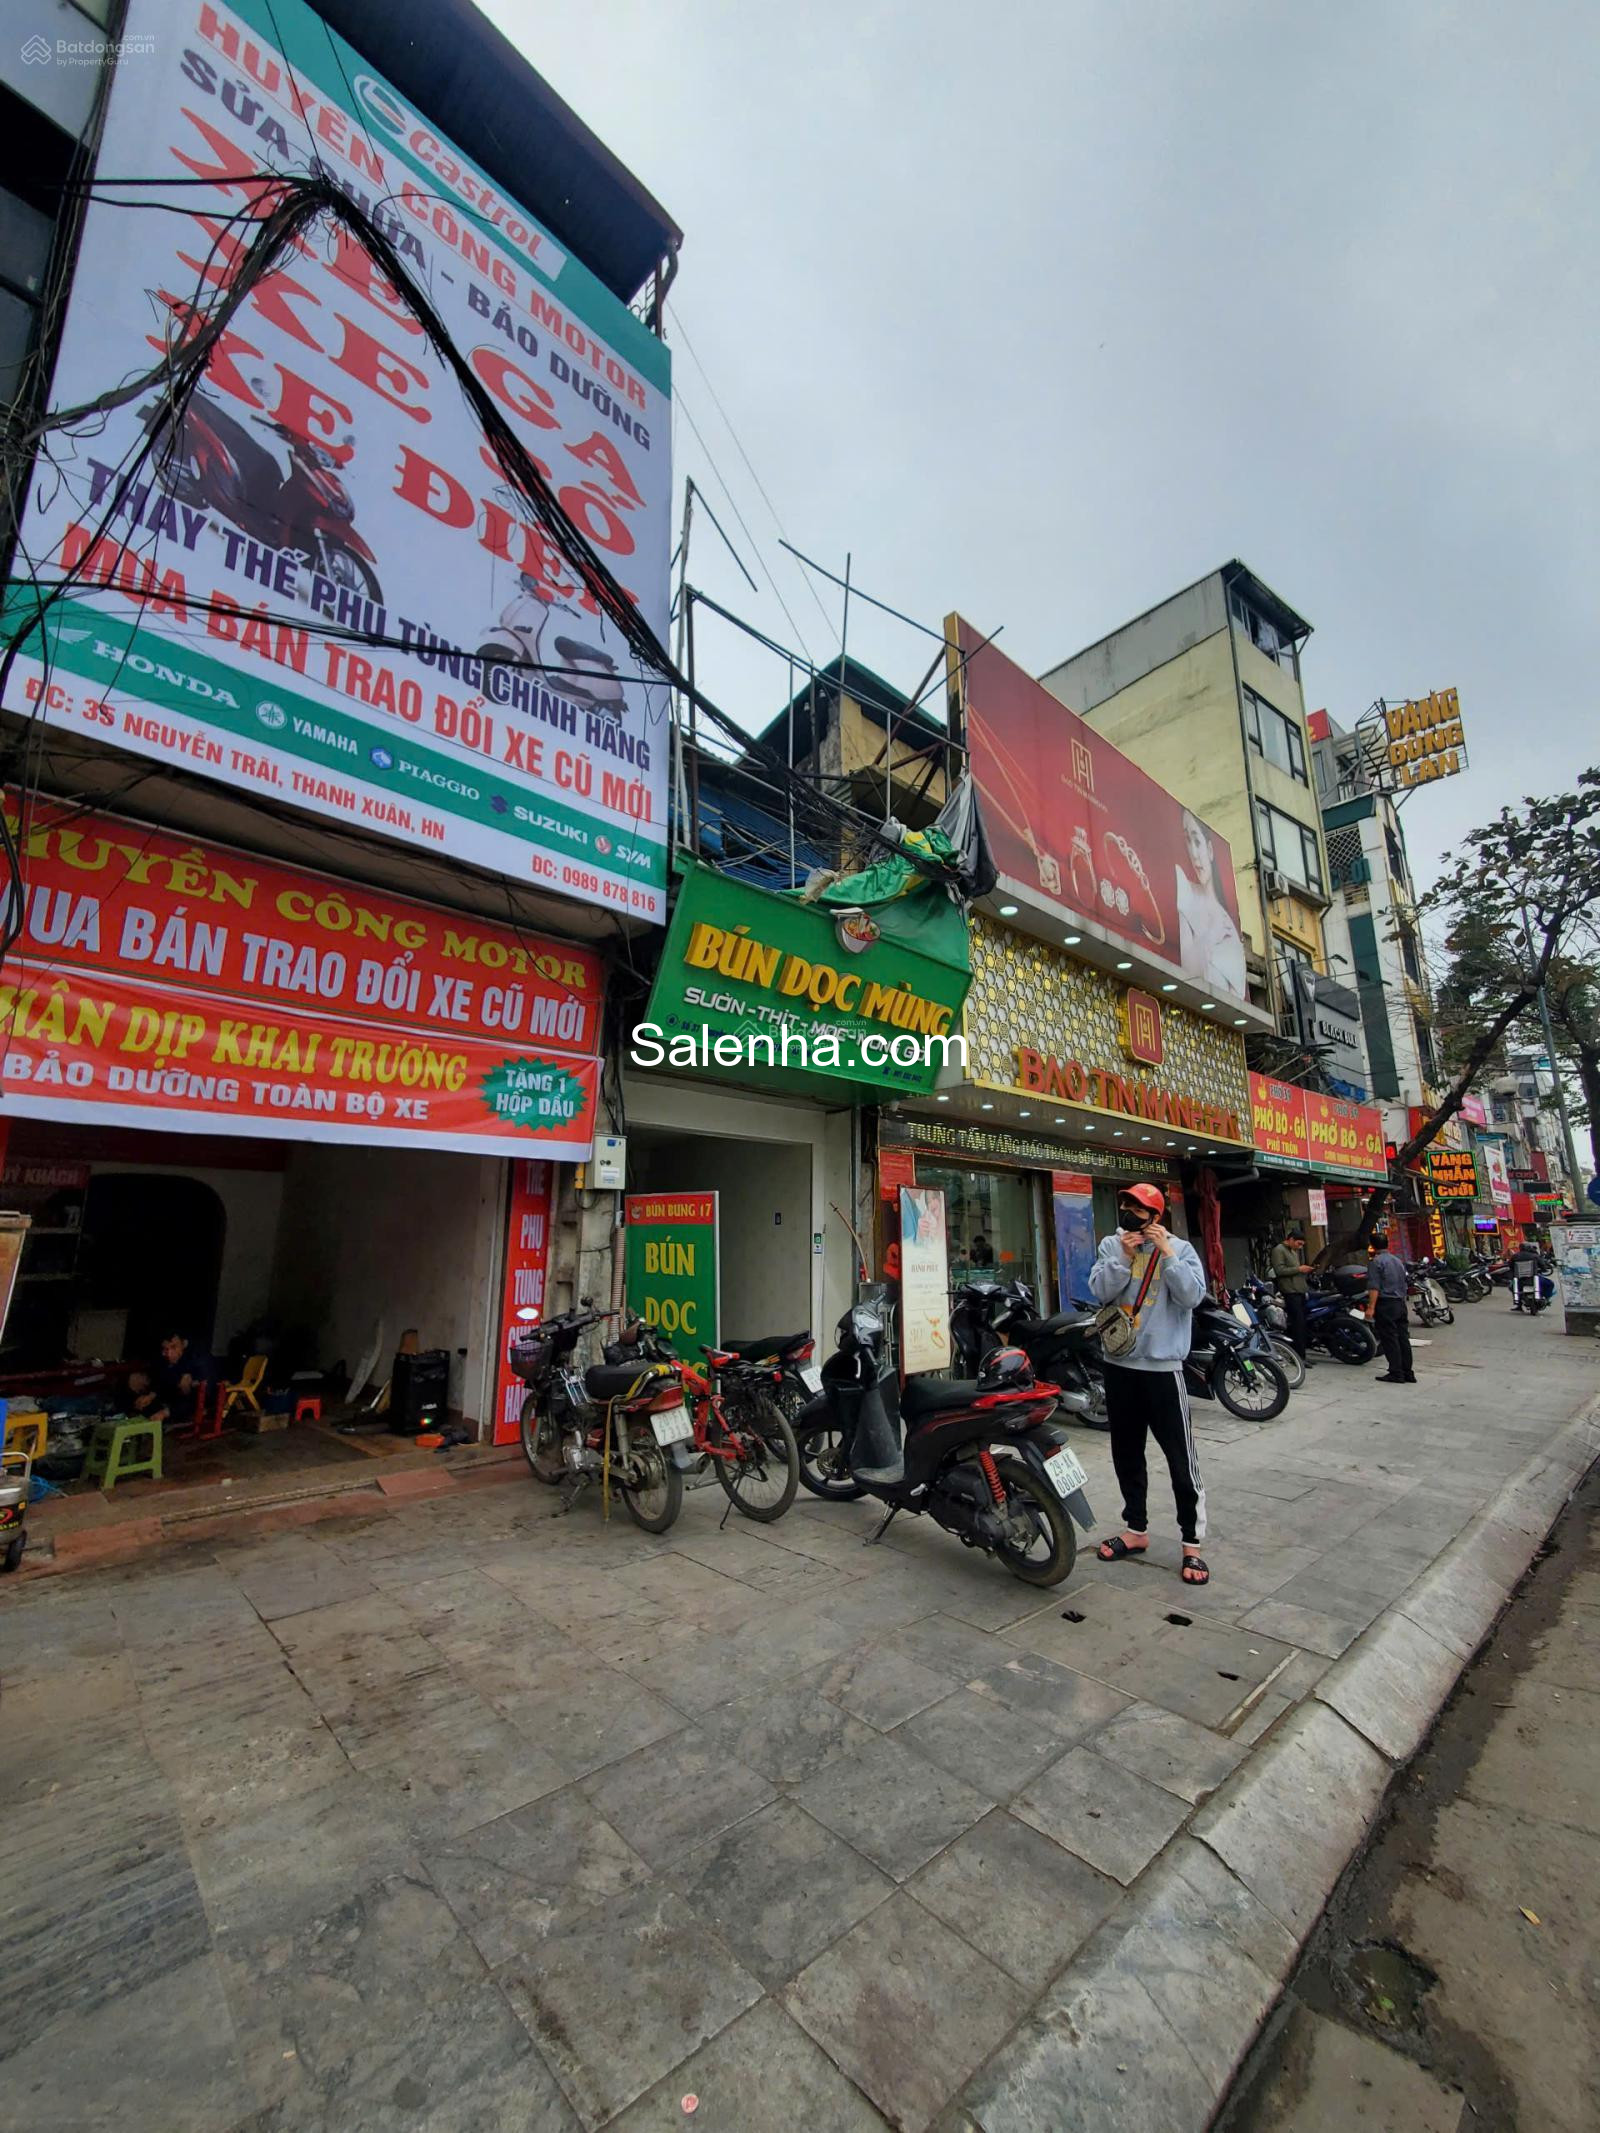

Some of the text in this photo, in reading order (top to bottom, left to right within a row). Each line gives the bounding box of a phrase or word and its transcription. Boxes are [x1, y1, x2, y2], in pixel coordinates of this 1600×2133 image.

[408, 129, 540, 261] Castrol
[180, 49, 289, 160] SỬA
[468, 282, 538, 357] BẢO
[550, 349, 650, 451] DƯỠNG
[402, 181, 517, 298] CÔNG
[530, 289, 647, 411] MOTOR
[472, 348, 647, 508] GA
[87, 457, 210, 551] THAY
[398, 615, 483, 694] TÙNG
[491, 664, 577, 736] CHÍNH
[586, 713, 650, 771] HÃNG
[60, 522, 652, 824] MUA BÁN TRAO ĐỔI XE CŨ MỚI
[25, 677, 445, 841] ĐC: 35 NGUYỄN TRÃI, THANH XUÂN, HN
[92, 639, 651, 869] HONDA YAMAHA PIAGGIO SUZUKI SYM
[531, 854, 655, 912] ĐC: 0989 878 816
[119, 905, 227, 977] BÁN
[243, 931, 346, 998] TRAO
[356, 951, 421, 1013] ĐỔI
[427, 974, 473, 1022] XE
[481, 983, 523, 1030] CŨ
[530, 994, 585, 1041] MỚI
[276, 890, 428, 948] CÔNG
[441, 930, 587, 988] MOTOR
[684, 922, 953, 1037] BÚN DỌC MÙNG
[2, 1051, 430, 1120] BẢO DƯỠNG TOÀN BỘ XE
[120, 1005, 205, 1068] DỊP
[212, 1020, 322, 1074] KHAI
[330, 1036, 467, 1091] TRƯƠNG
[559, 1077, 567, 1094] 1
[1311, 1117, 1338, 1145] PHỞ
[520, 1214, 545, 1257] PHỤ
[645, 1235, 695, 1277] BÚN
[699, 1202, 712, 1217] 17
[514, 1260, 543, 1306] TÙNG
[645, 1296, 697, 1339] DỌC
